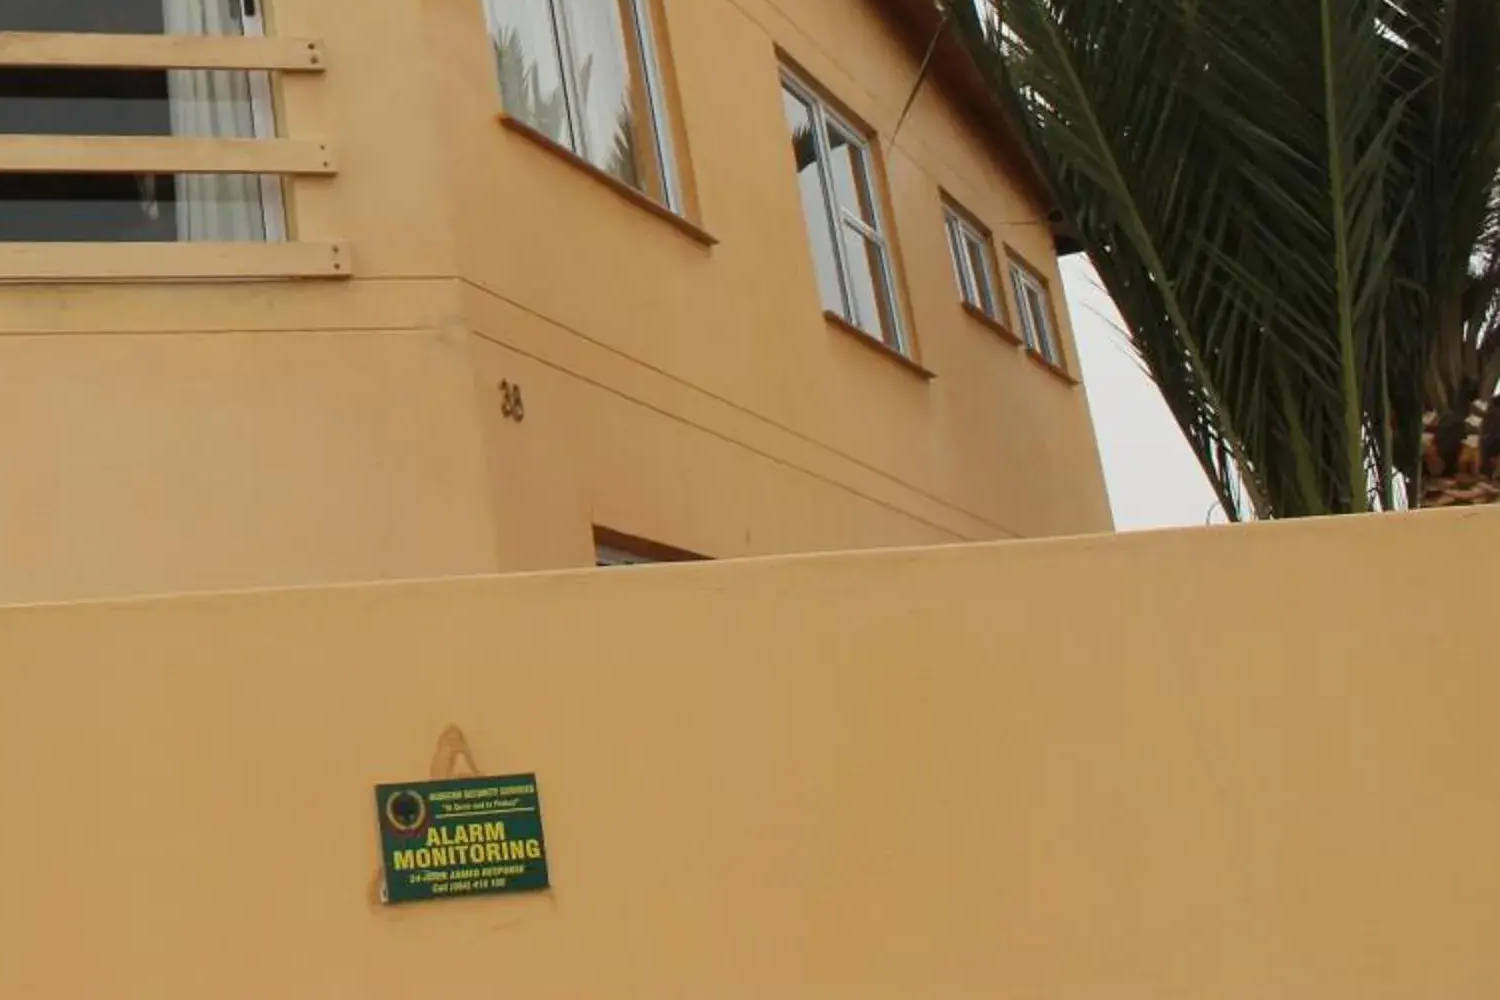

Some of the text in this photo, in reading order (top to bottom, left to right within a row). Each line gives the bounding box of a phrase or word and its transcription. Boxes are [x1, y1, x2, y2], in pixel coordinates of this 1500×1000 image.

[498, 378, 524, 424] 38
[426, 820, 506, 847] ALARM
[393, 838, 541, 870] MONITORING
